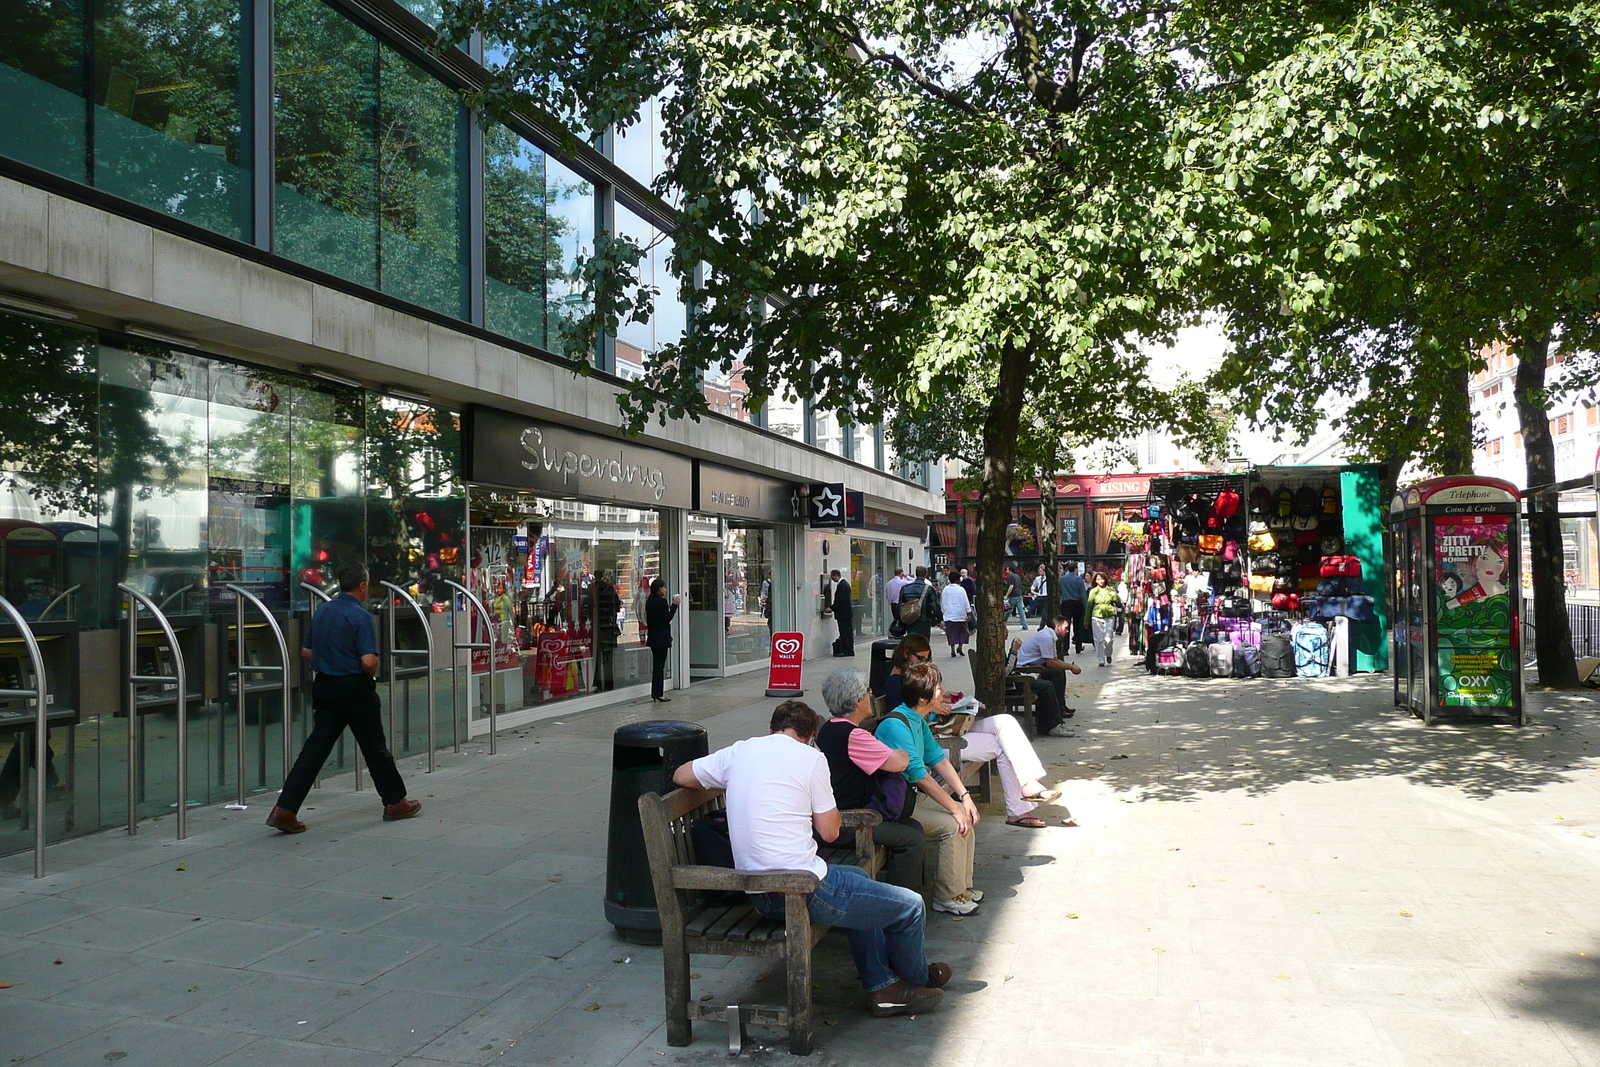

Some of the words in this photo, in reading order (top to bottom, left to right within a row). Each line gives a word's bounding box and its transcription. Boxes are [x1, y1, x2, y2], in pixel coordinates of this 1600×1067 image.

[520, 426, 667, 500] Superdrug
[1100, 482, 1139, 493] RISING
[1449, 490, 1492, 500] Telephone
[1466, 505, 1473, 513] &
[1443, 535, 1471, 546] ZITTY
[1440, 545, 1448, 553] to
[1449, 545, 1486, 556] PRETTY
[1472, 587, 1482, 598] OXY
[472, 649, 481, 659] get
[1459, 675, 1490, 687] OXY
[1447, 691, 1499, 699] Superdrug
